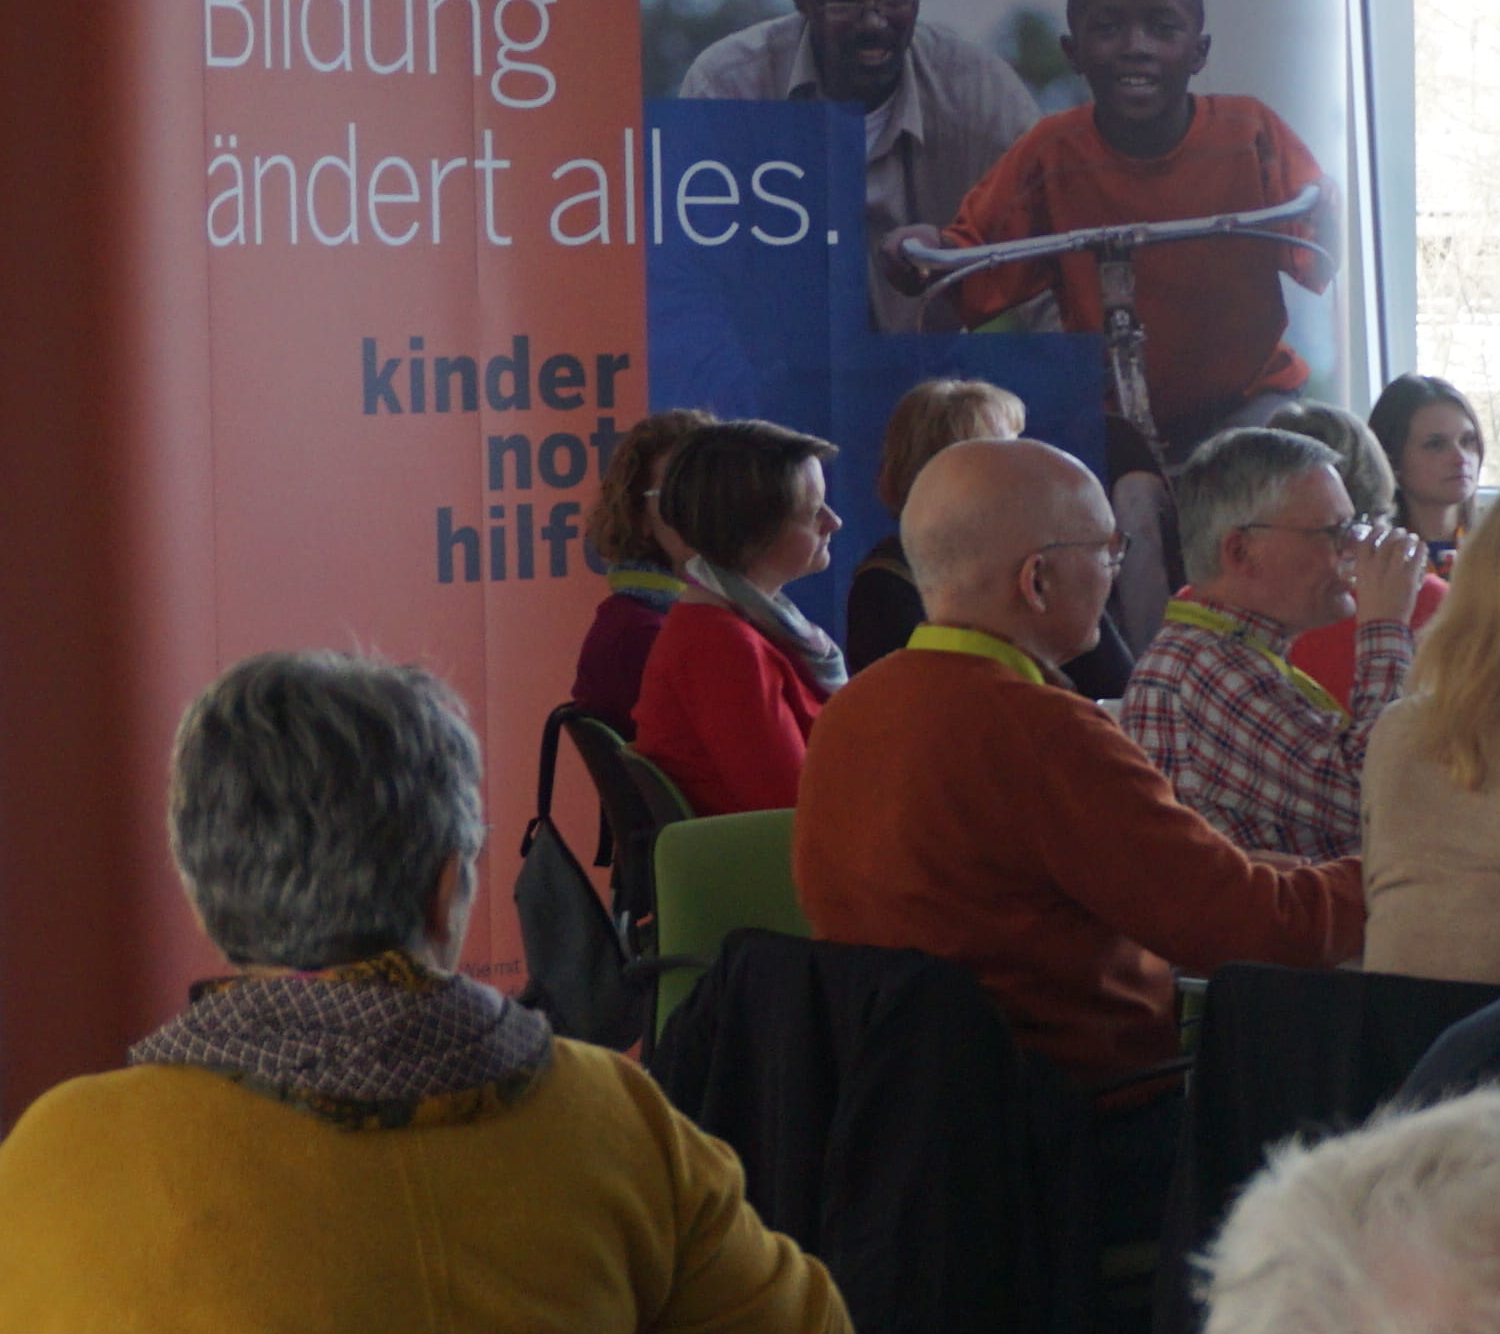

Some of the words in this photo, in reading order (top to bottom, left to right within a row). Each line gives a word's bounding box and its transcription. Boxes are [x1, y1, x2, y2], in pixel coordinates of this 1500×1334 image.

[206, 121, 512, 247] ändert
[549, 127, 839, 247] alles.
[362, 335, 630, 415] kinder
